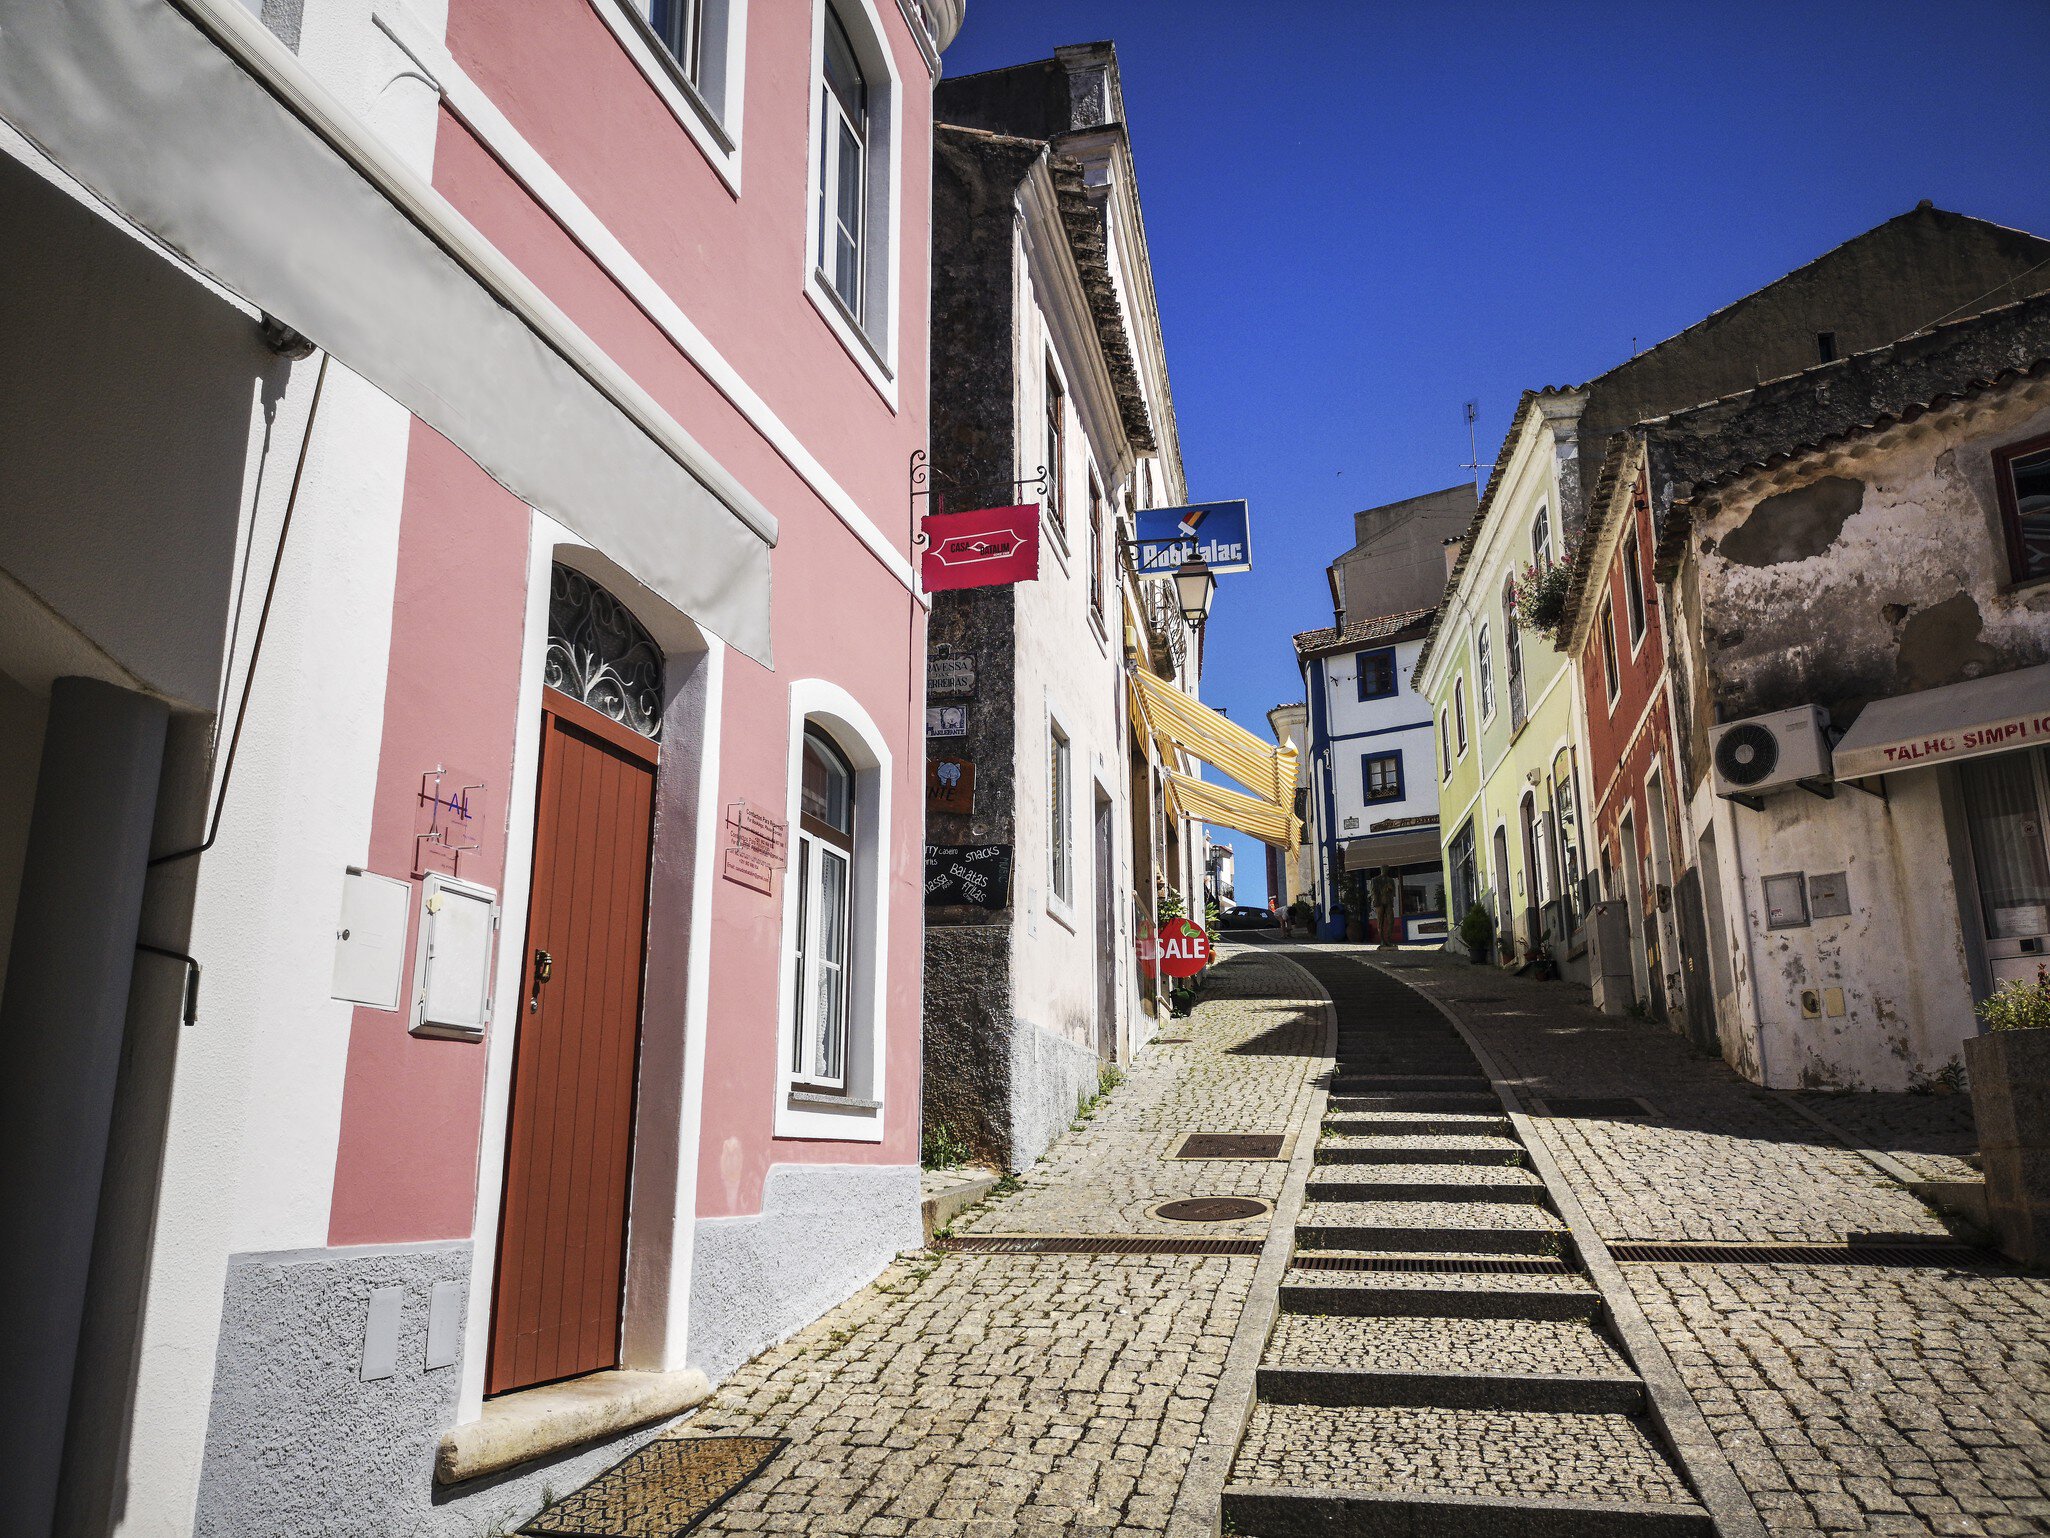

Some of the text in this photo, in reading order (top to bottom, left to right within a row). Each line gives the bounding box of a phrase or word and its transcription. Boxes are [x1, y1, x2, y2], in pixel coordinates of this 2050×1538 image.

[950, 541, 971, 554] CASA
[1143, 539, 1242, 569] Robbalac
[1883, 737, 1955, 762] TALHO
[965, 845, 1000, 863] snacks
[949, 862, 989, 888] Batatas
